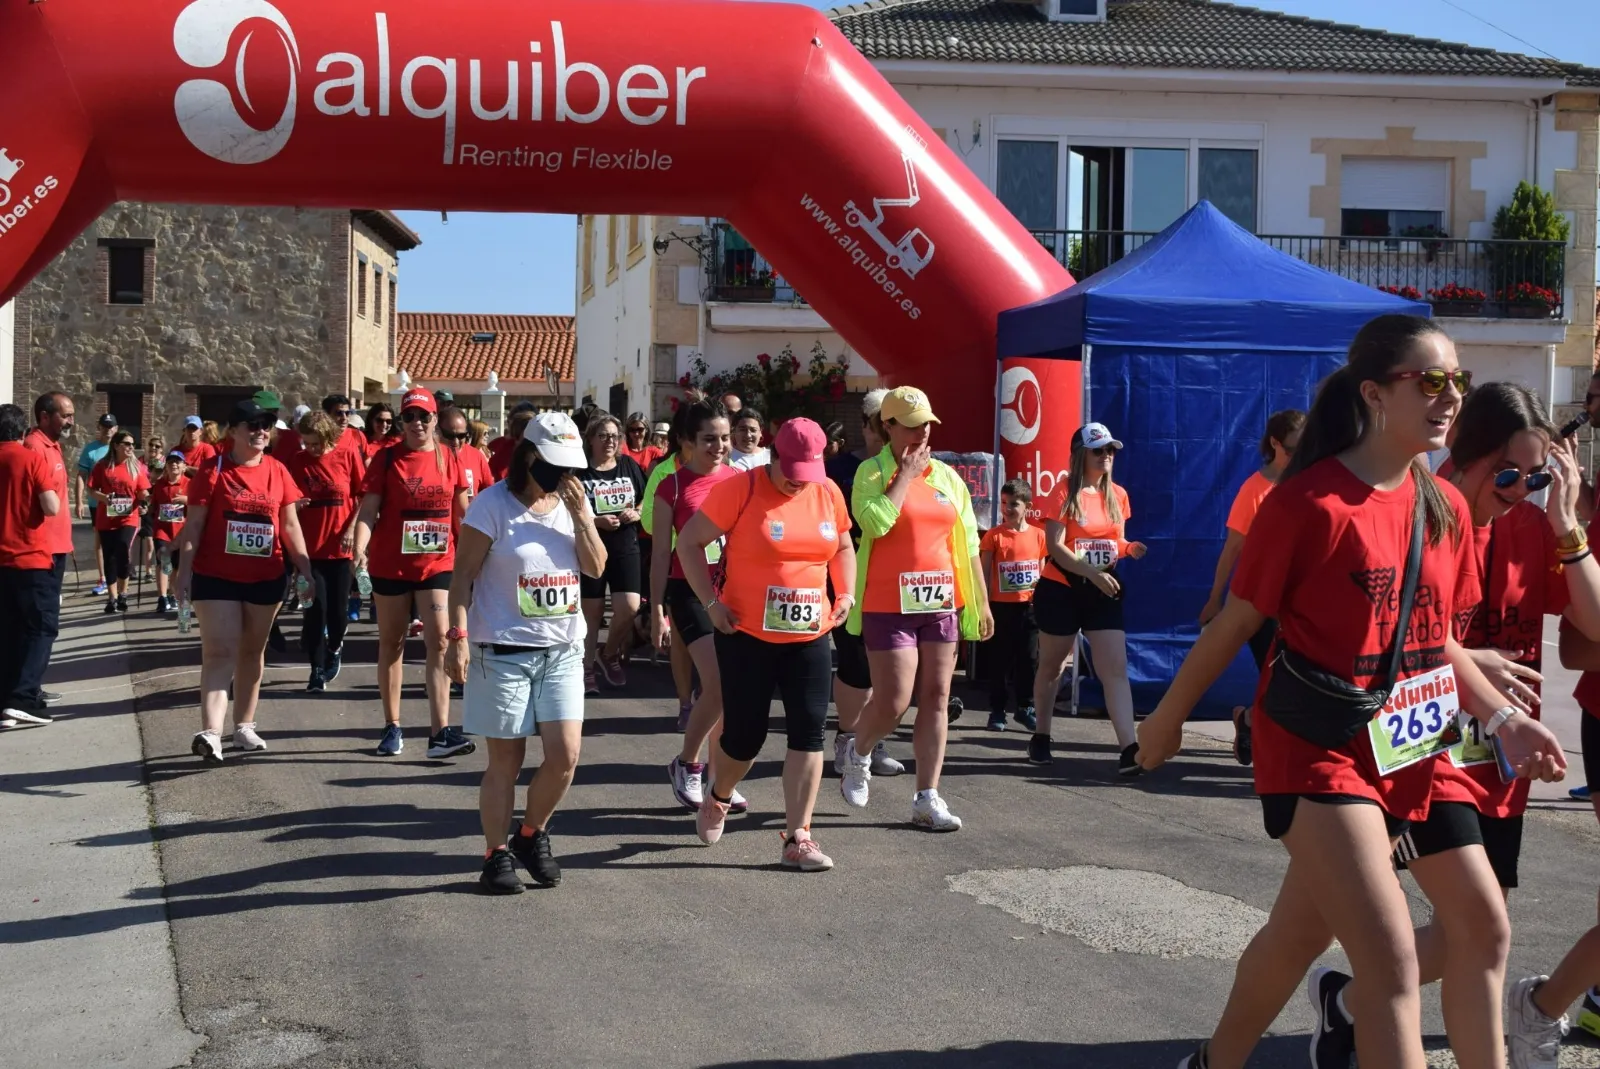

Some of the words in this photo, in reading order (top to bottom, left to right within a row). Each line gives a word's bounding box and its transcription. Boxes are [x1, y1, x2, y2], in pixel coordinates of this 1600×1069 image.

[313, 12, 706, 165] alquiber
[459, 144, 563, 173] Renting
[572, 147, 673, 171] Flexible
[0, 175, 59, 239] iber.es
[800, 193, 922, 320] www.alquiber.es
[604, 494, 626, 506] 139
[112, 504, 128, 513] 131
[229, 522, 272, 536] bedunia
[405, 522, 449, 533] bedunia
[237, 533, 264, 548] 150
[413, 532, 438, 546] 151
[1085, 551, 1111, 565] 115
[1000, 561, 1039, 573] bedunia
[519, 572, 579, 588] bedunia
[901, 573, 953, 587] bedunia
[1008, 571, 1033, 585] 285
[532, 587, 568, 608] 101
[767, 588, 821, 604] bedunia
[912, 585, 945, 603] 174
[779, 603, 812, 622] 183
[1373, 675, 1455, 720] edunia
[1387, 701, 1443, 749] 263
